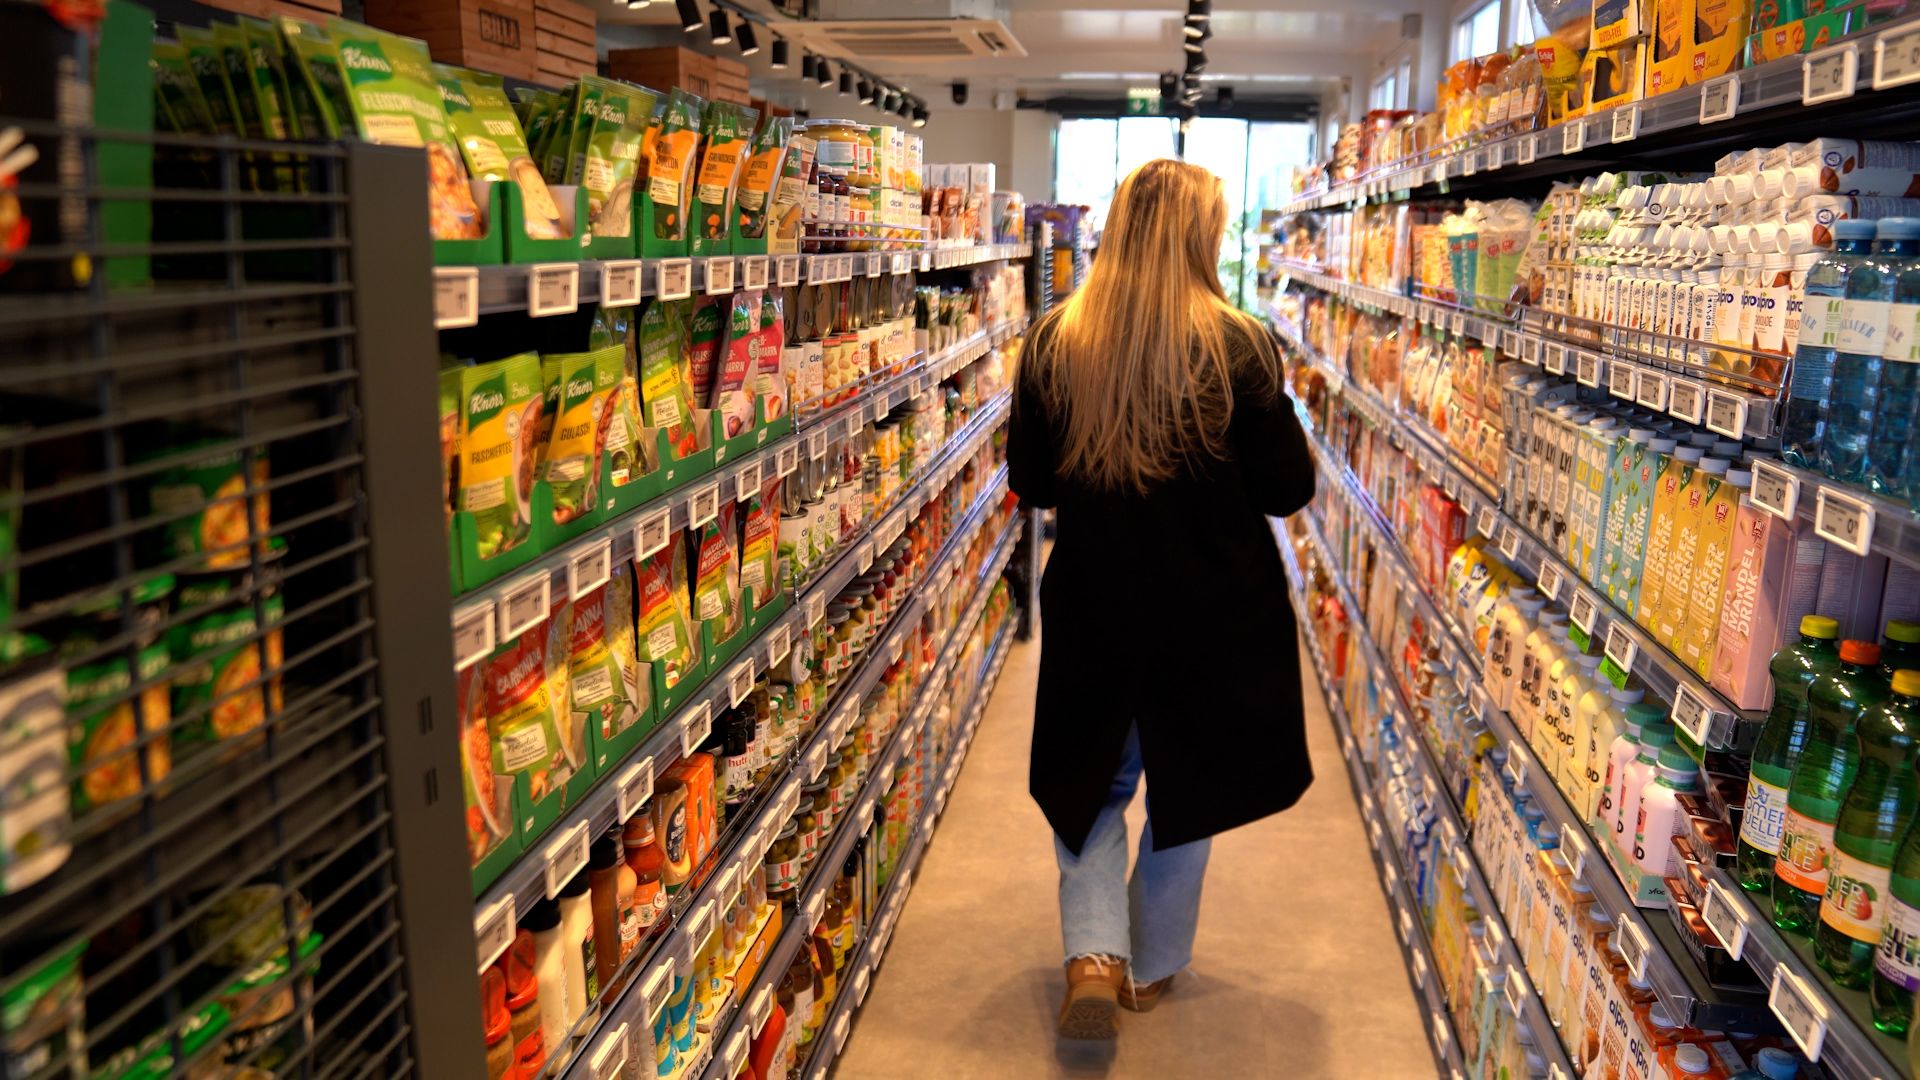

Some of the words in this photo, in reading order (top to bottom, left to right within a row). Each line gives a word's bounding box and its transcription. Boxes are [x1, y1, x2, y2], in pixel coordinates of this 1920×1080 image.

[470, 391, 505, 415] Knorr
[567, 379, 594, 398] Knorr
[471, 440, 513, 466] FASCHIERTES
[1673, 527, 1690, 588] HAFER
[1699, 543, 1718, 608] HAFER
[1728, 547, 1756, 631] MANDEL
[1737, 572, 1758, 637] DRINK
[1573, 933, 1588, 966] alpro
[1590, 965, 1607, 1000] alpro
[1609, 999, 1629, 1039] alpro
[1630, 1038, 1649, 1080] alpro
